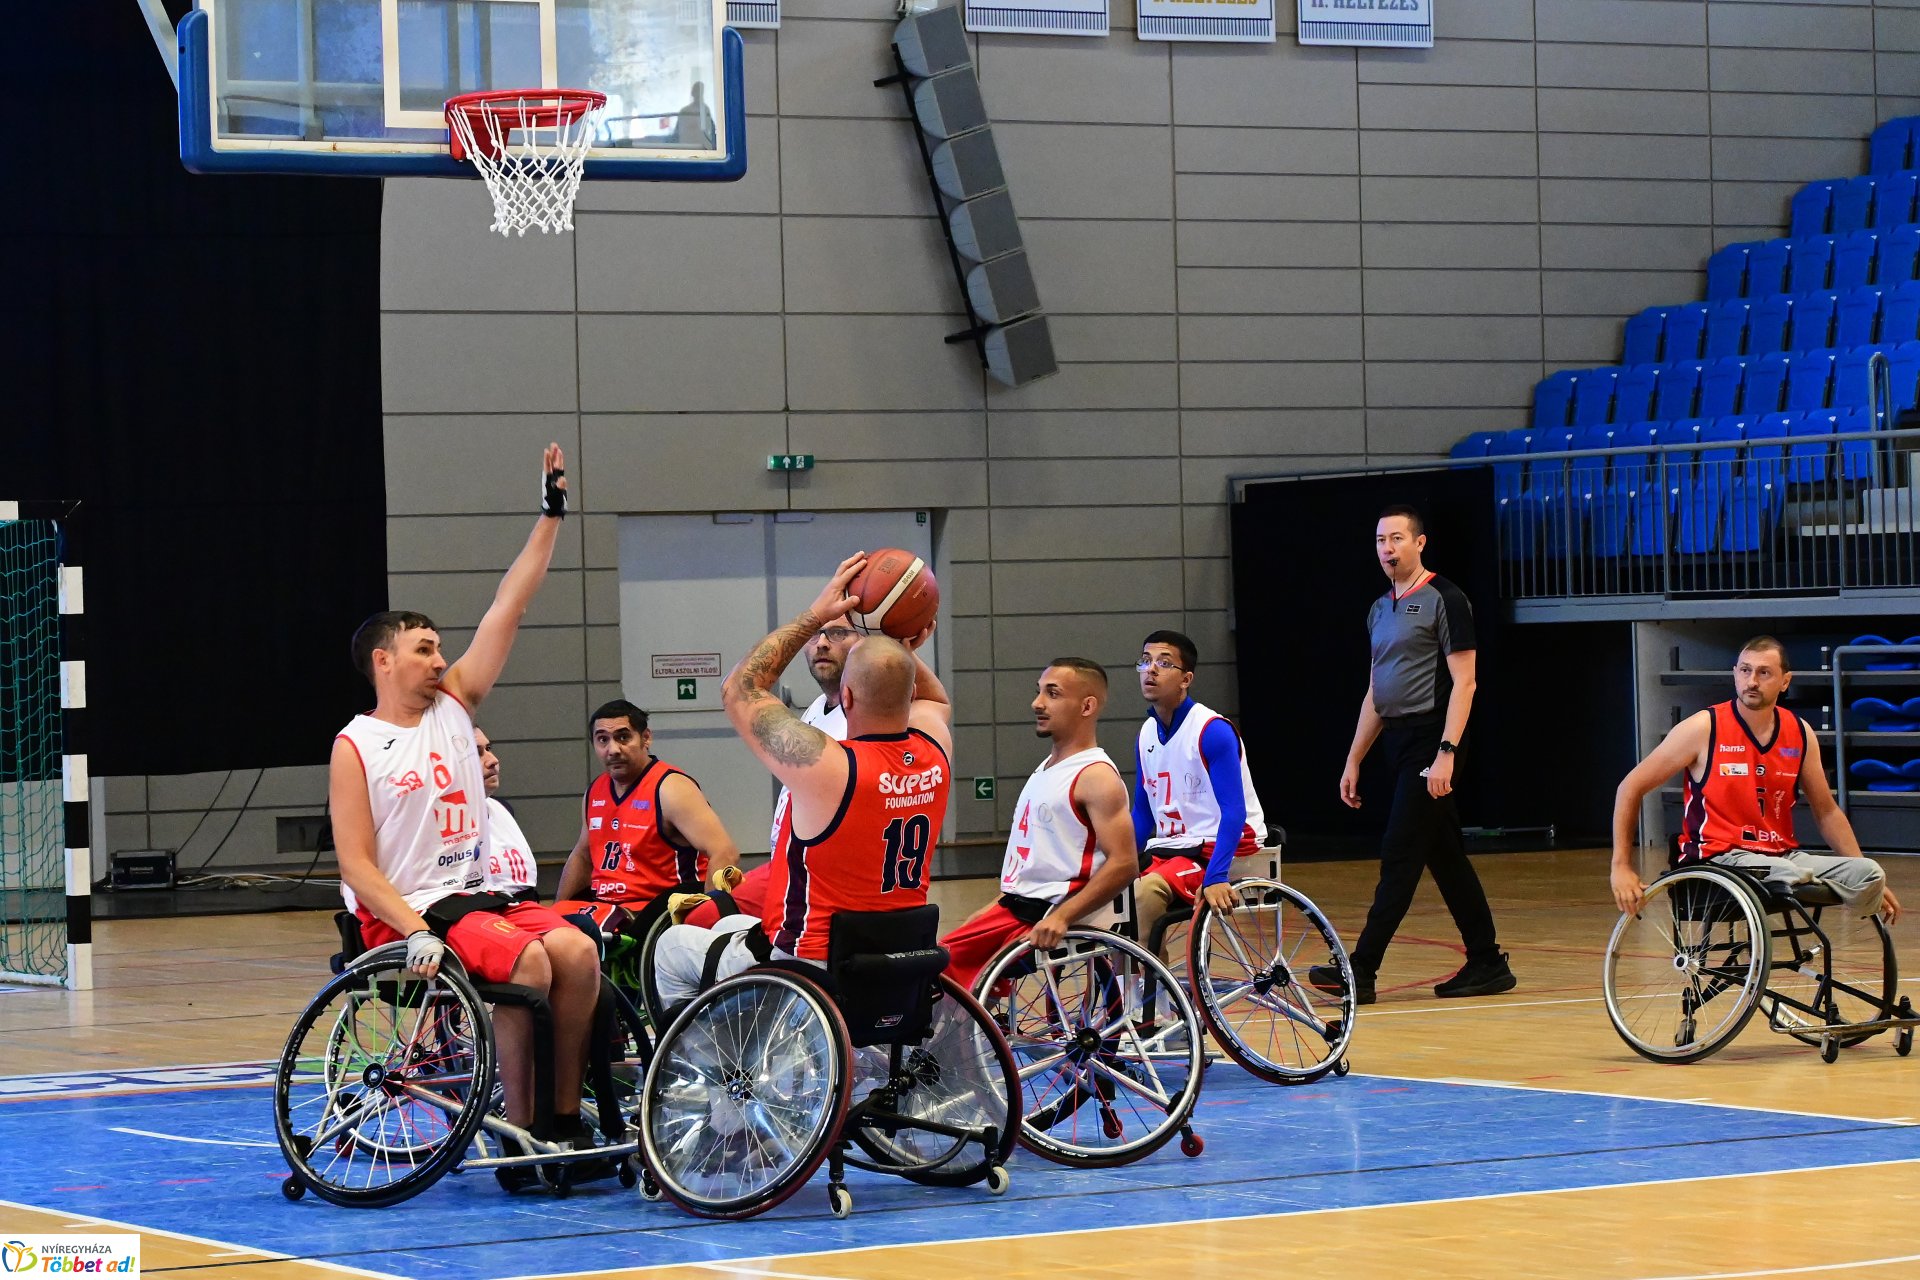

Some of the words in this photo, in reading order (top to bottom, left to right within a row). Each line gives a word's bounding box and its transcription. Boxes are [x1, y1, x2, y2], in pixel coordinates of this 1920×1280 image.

[1719, 743, 1746, 753] hama
[429, 751, 453, 790] 6
[878, 764, 943, 795] SUPER
[885, 791, 935, 810] FOUNDATION
[1157, 771, 1172, 806] 7
[1018, 798, 1031, 838] 4
[442, 831, 480, 847] marso
[881, 813, 931, 894] 19
[437, 847, 473, 867] Oplus
[502, 848, 528, 884] 10
[600, 840, 623, 873] 13
[598, 882, 627, 895] BRD
